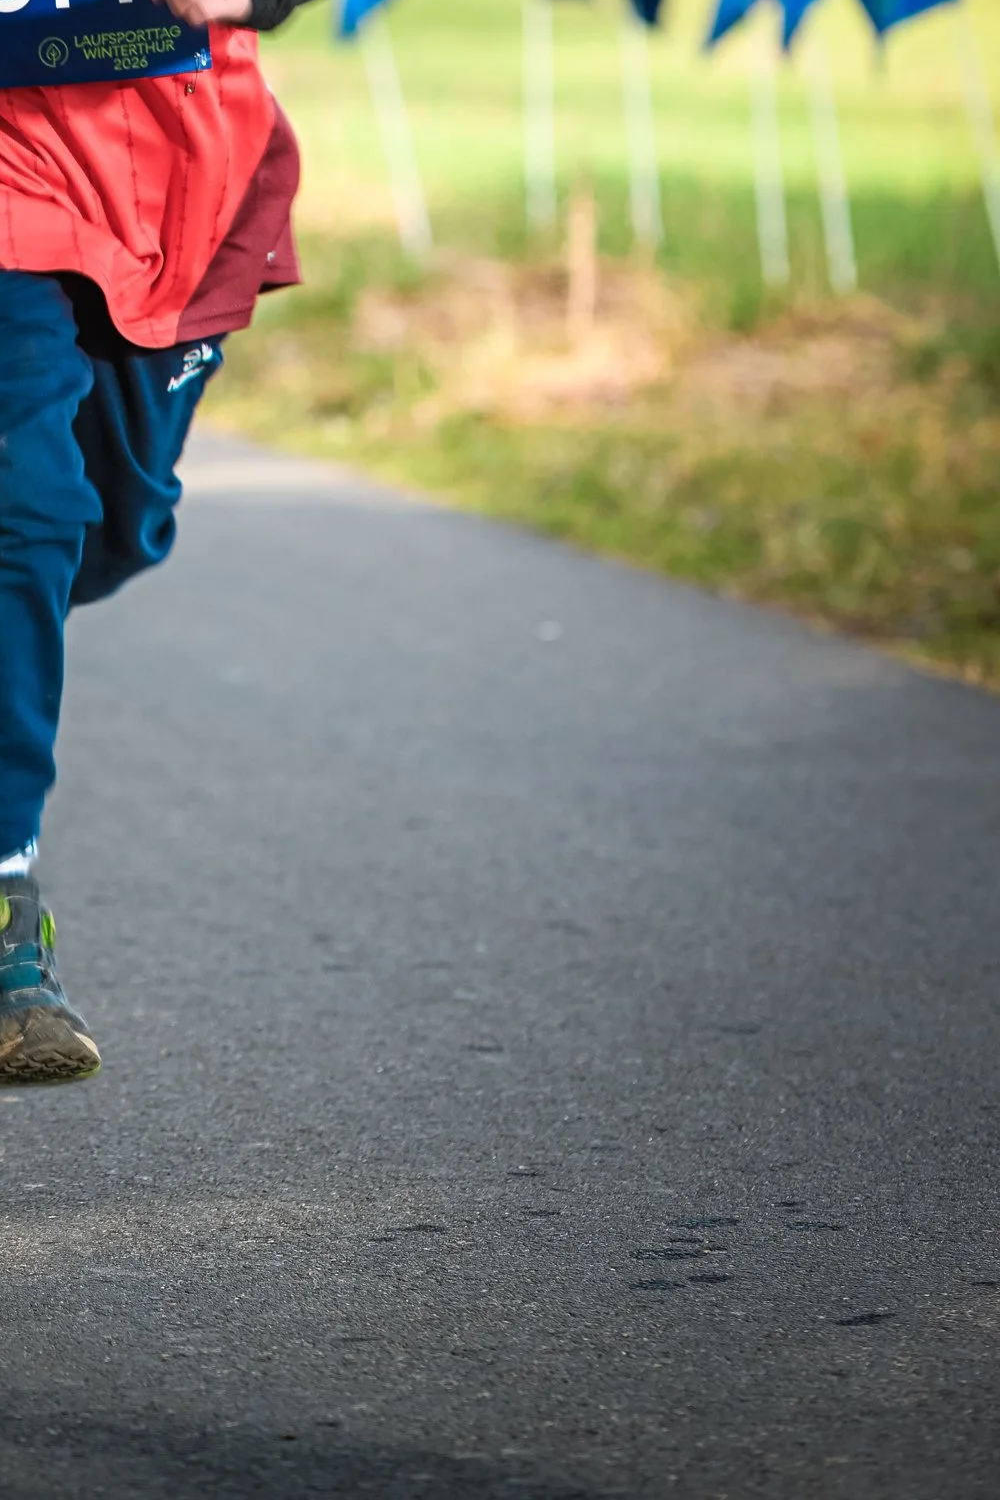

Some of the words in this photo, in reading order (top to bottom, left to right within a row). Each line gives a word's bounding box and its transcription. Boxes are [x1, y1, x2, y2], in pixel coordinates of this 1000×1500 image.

[74, 25, 181, 48] LAUFSPORTTAG
[83, 39, 175, 60] WINTERTHUR
[113, 56, 149, 70] 2026
